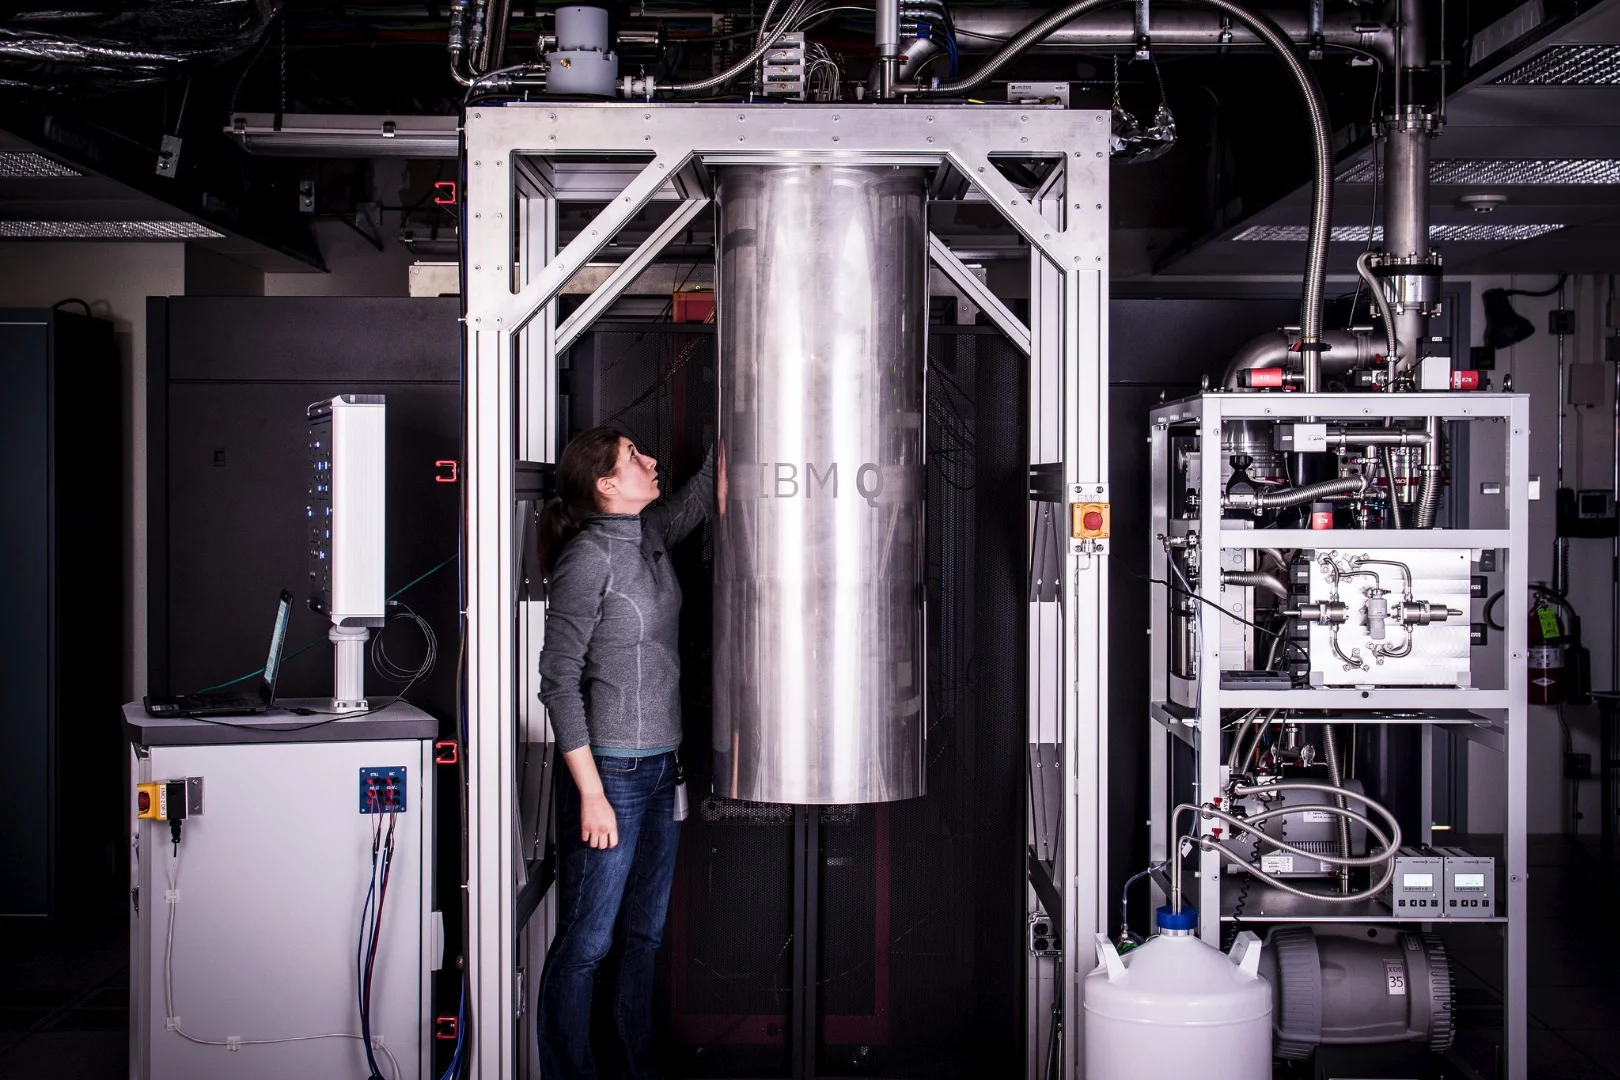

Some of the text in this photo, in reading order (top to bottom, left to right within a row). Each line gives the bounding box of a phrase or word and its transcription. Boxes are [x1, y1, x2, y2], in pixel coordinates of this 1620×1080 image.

[756, 462, 884, 507] IBM Q
[1389, 976, 1404, 988] 35
